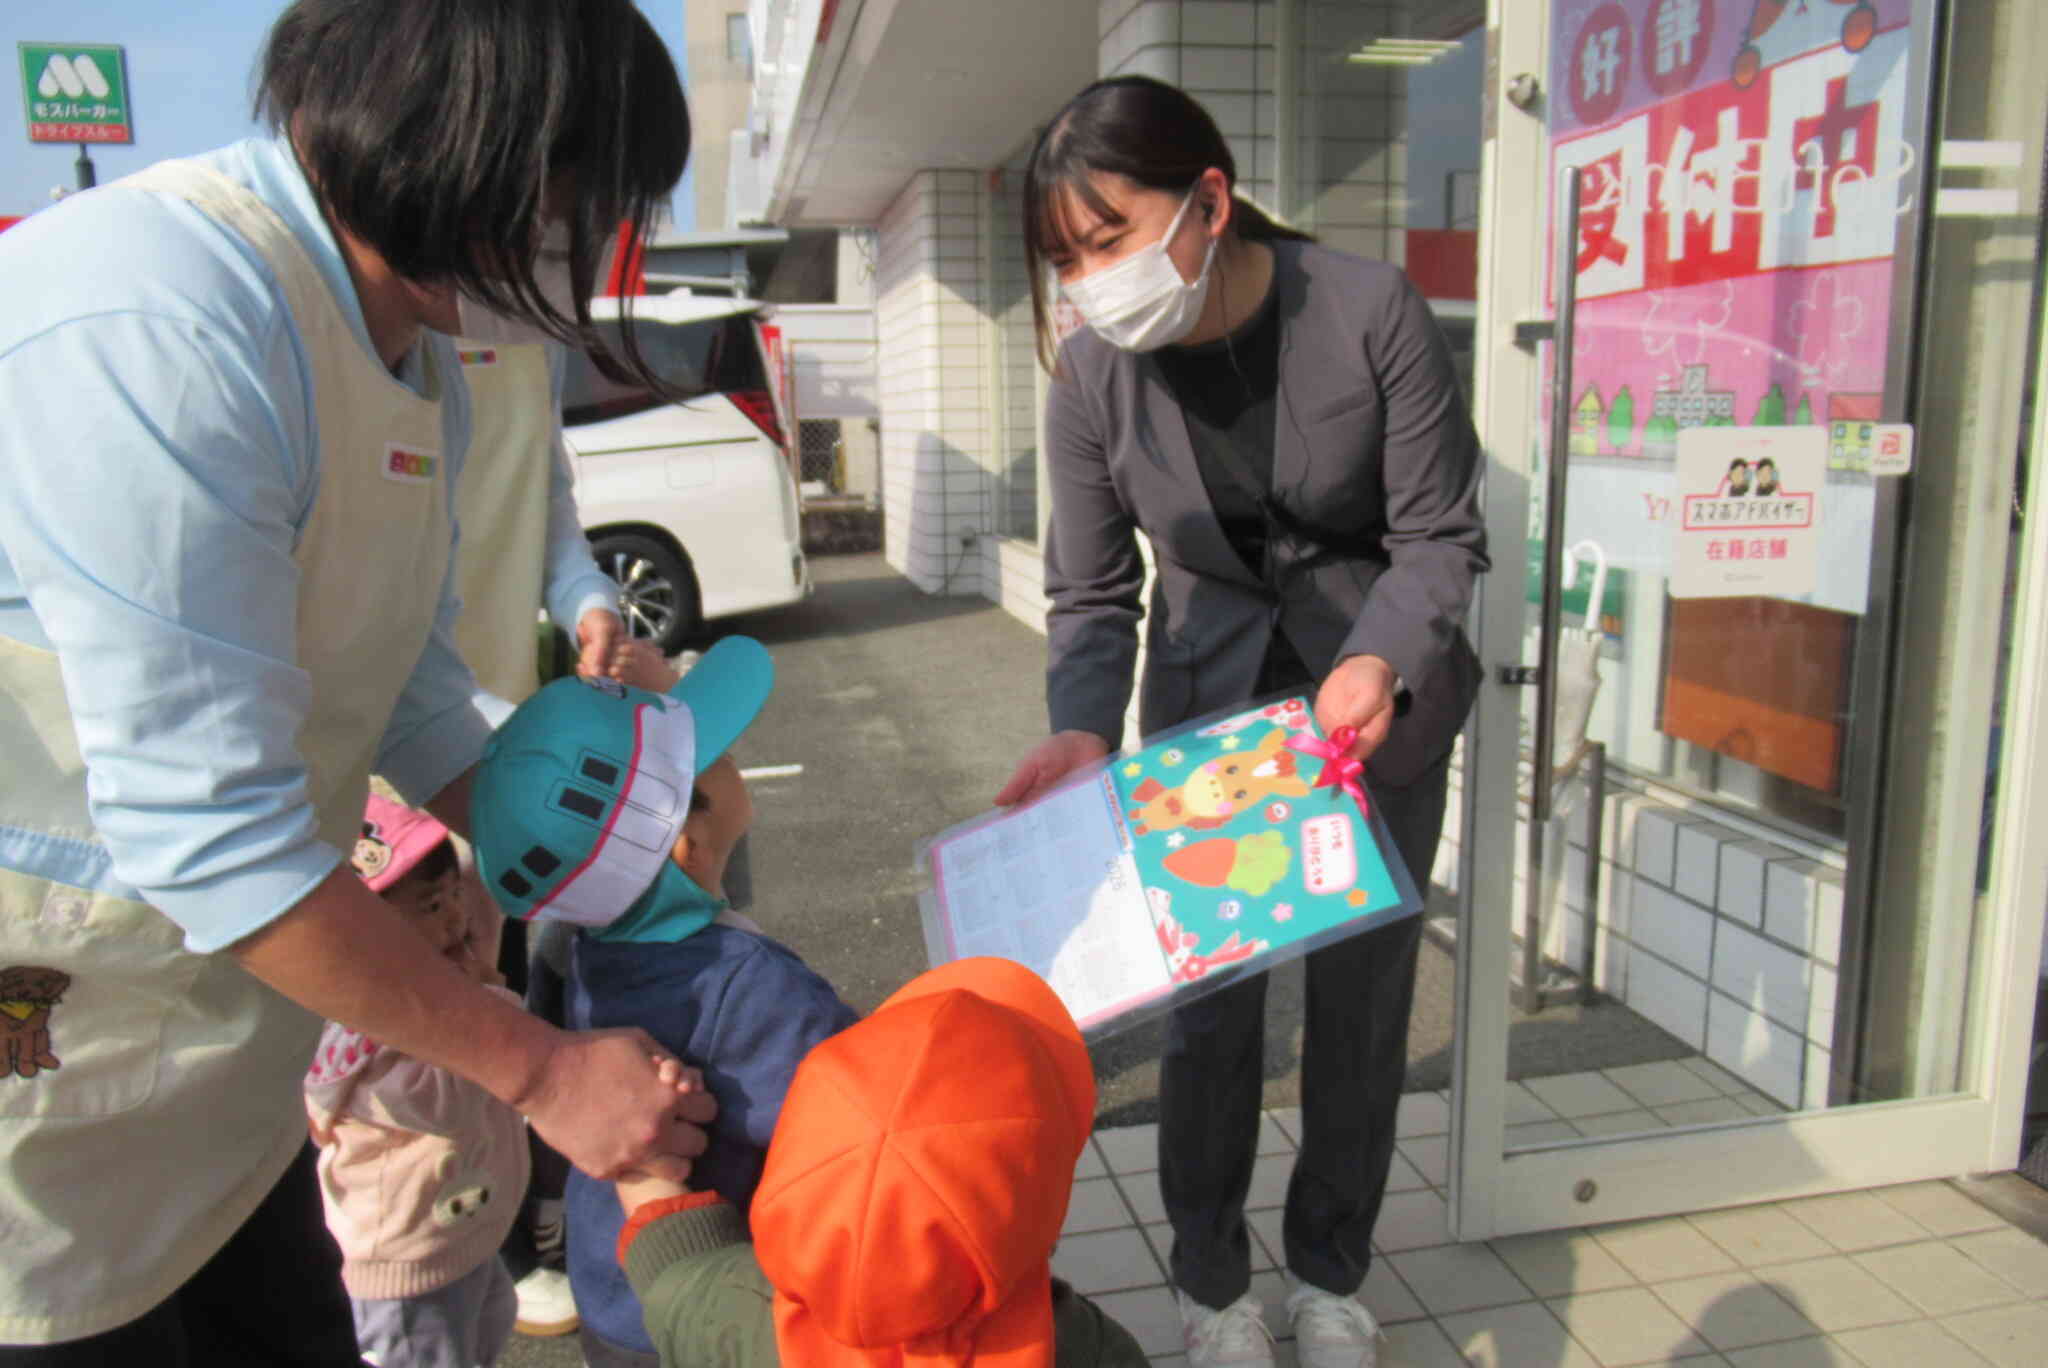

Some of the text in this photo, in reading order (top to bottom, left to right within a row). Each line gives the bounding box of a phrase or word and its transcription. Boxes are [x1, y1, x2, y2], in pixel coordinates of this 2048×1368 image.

[33, 103, 120, 119] モスバーガー
[1693, 501, 1806, 522] スマホアドバイザー
